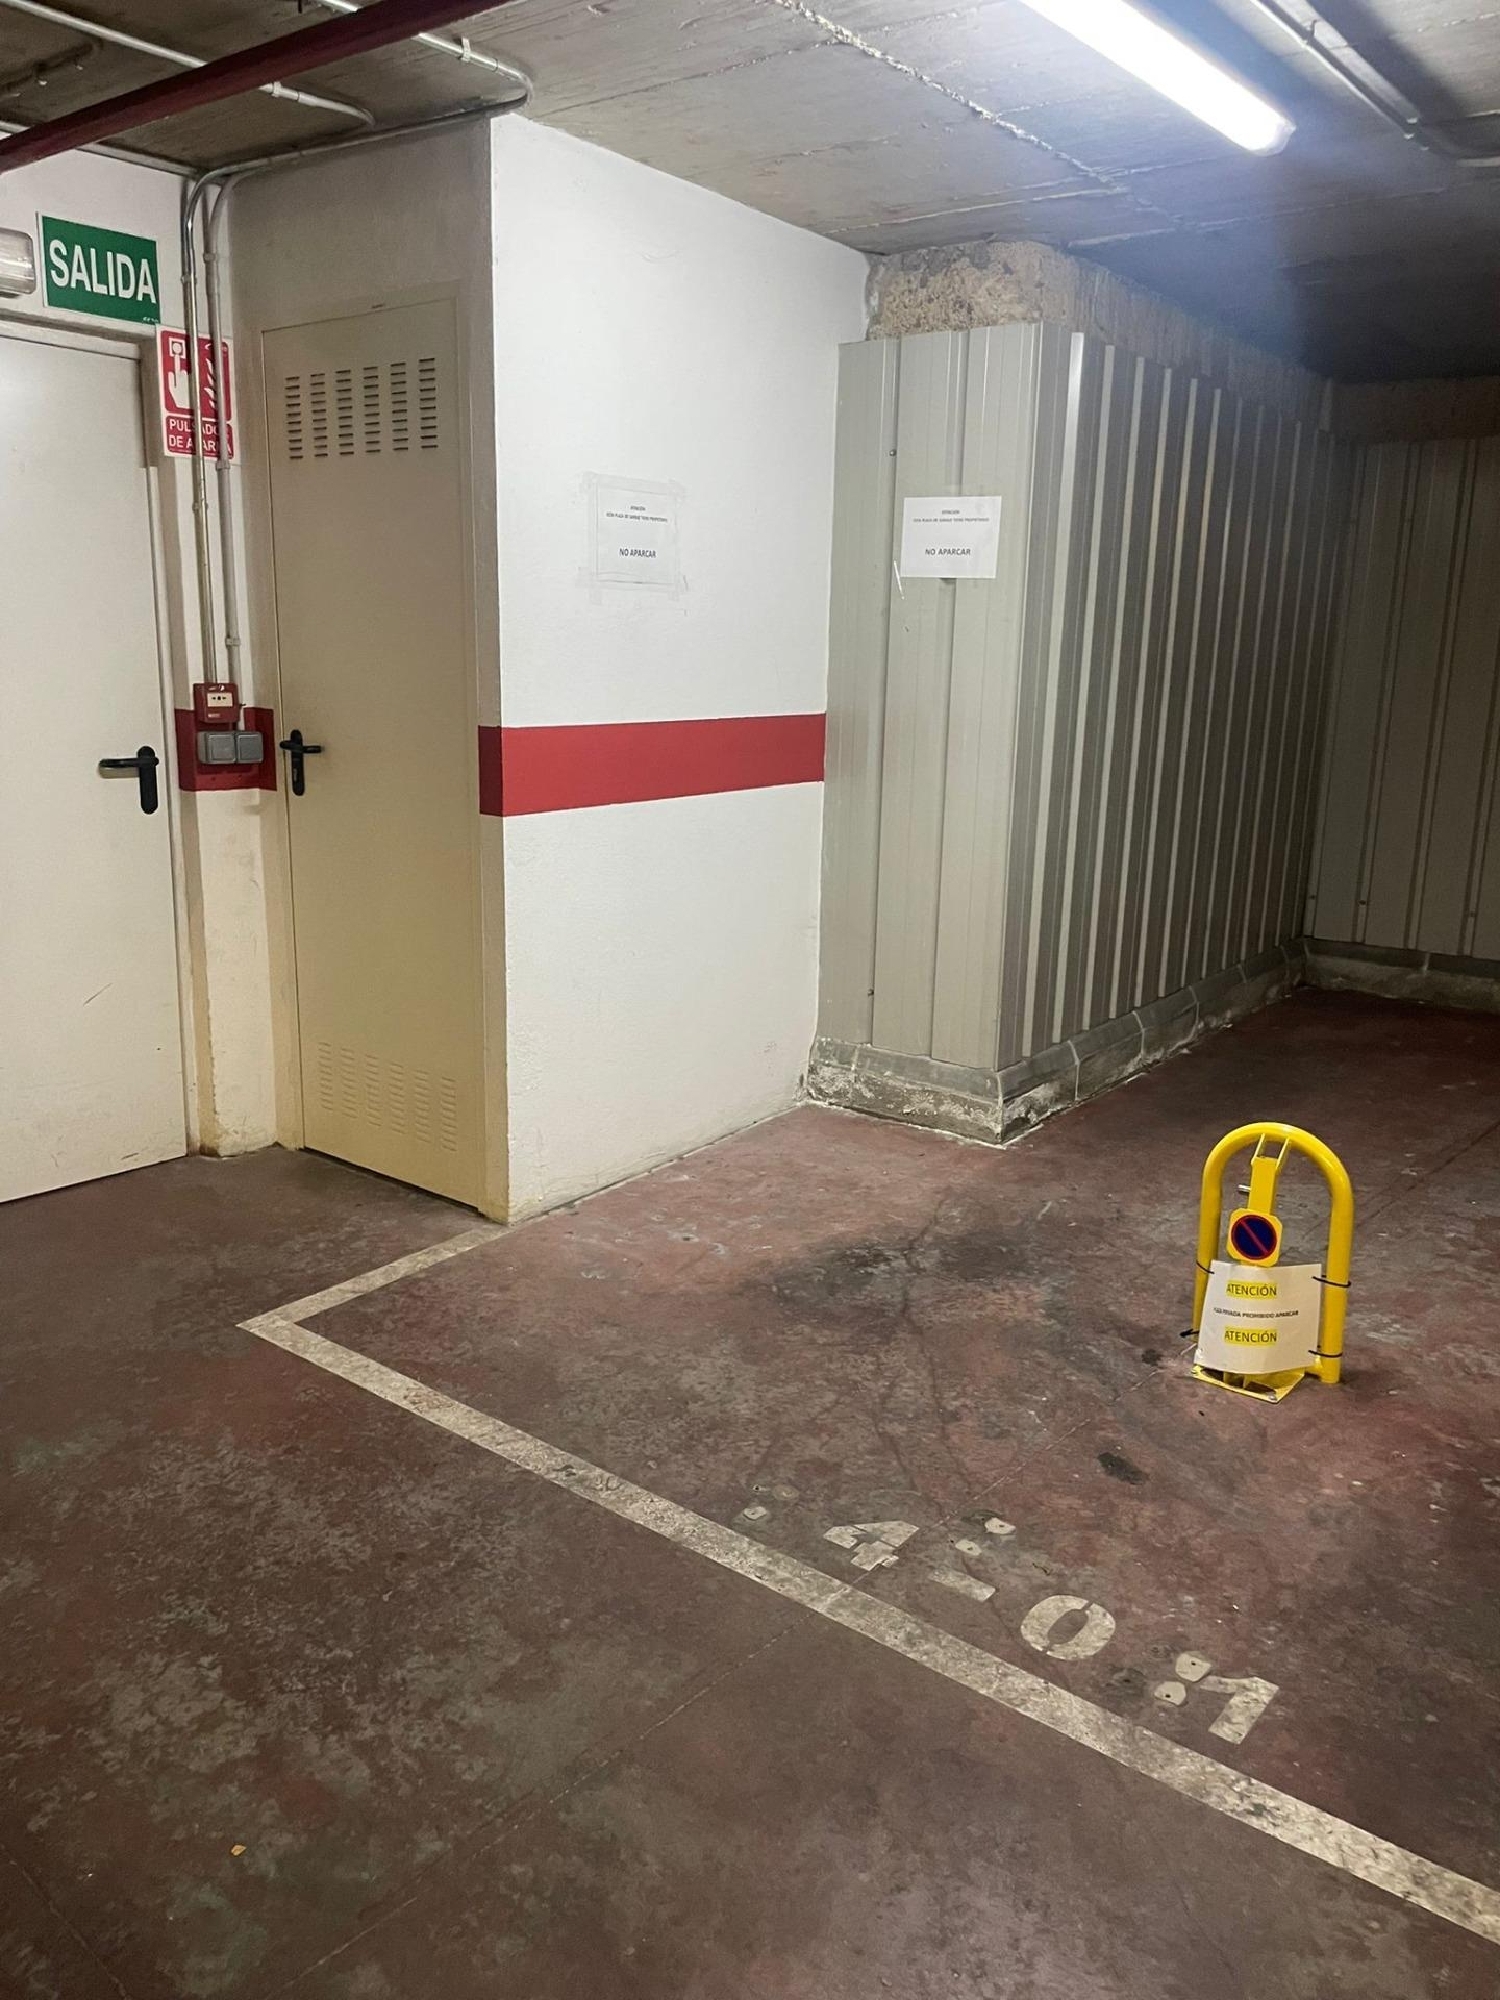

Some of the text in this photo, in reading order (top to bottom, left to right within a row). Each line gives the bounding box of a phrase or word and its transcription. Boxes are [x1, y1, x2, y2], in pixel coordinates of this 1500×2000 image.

[49, 239, 157, 304] SALIDA
[168, 434, 184, 449] DE
[619, 548, 656, 558] NO APARCAR
[1226, 1283, 1277, 1297] ATENCIÓN
[1225, 1330, 1277, 1343] ATENCIÓN
